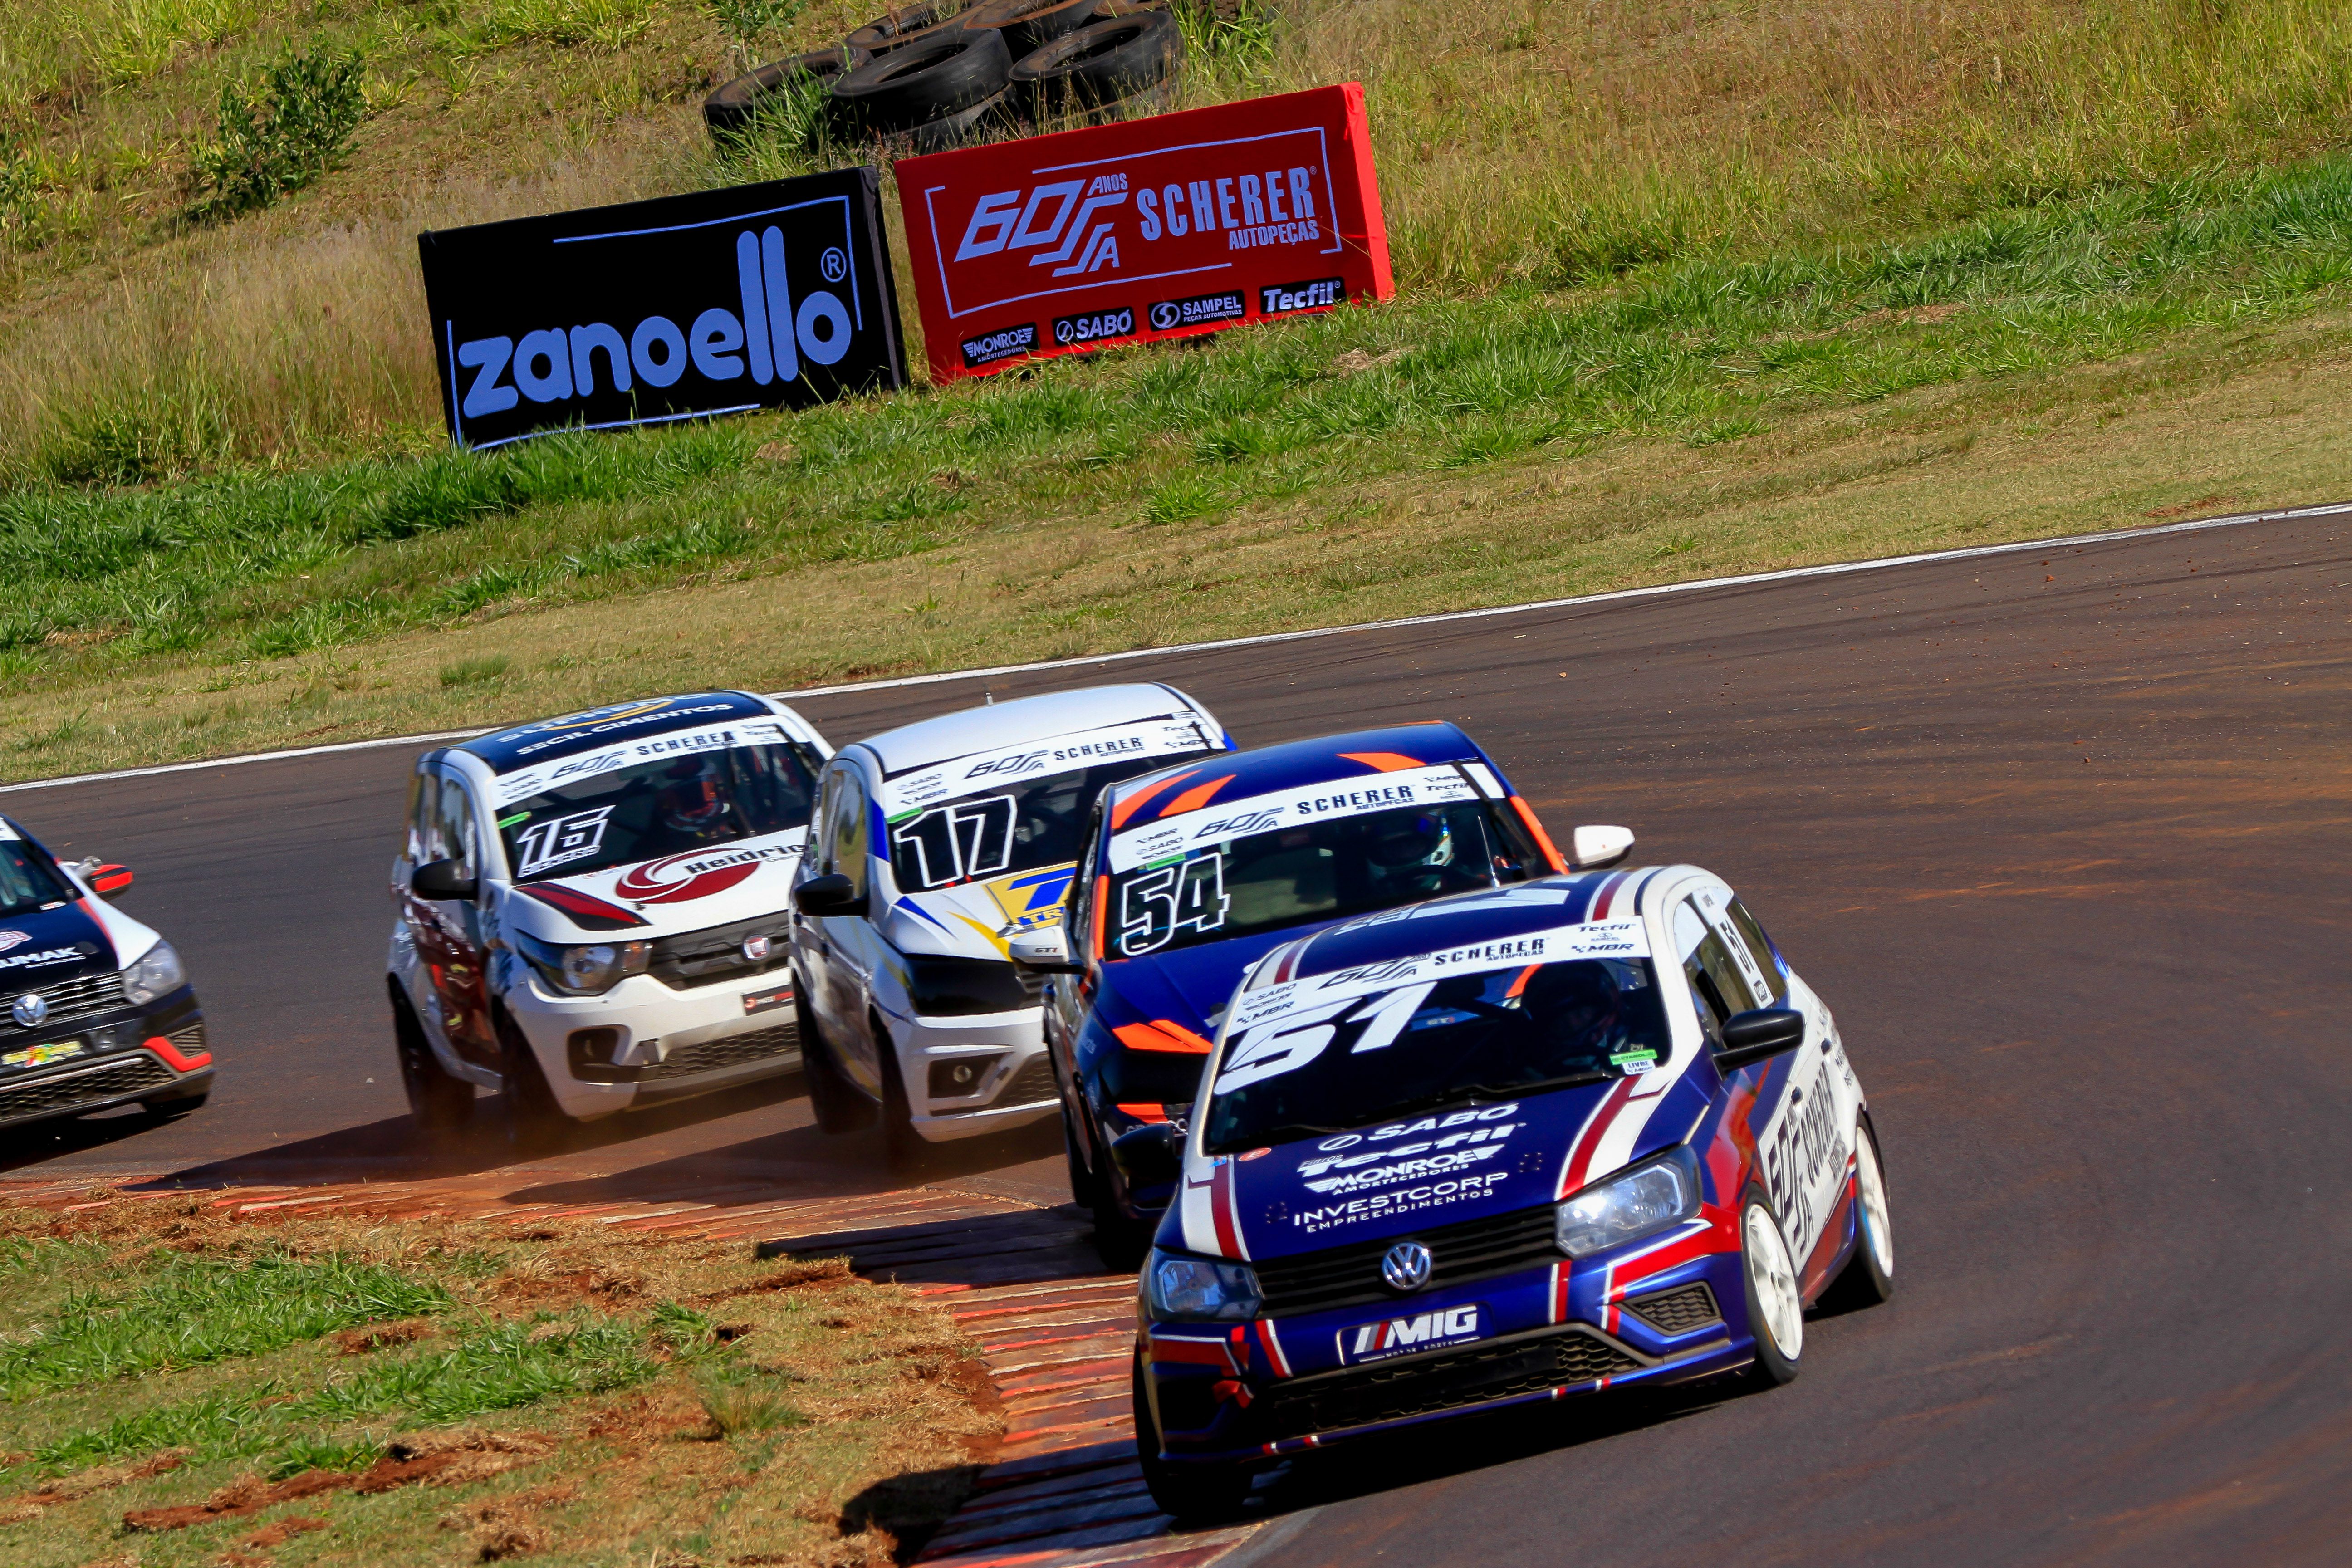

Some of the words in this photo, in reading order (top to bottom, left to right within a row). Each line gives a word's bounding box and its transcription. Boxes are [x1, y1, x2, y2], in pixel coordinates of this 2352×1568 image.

[1087, 172, 1129, 196] ANOS
[1137, 167, 1315, 241] SCHERER
[1229, 219, 1320, 250] AUTOPEÇAS
[1182, 295, 1241, 316] SAMPEL
[1263, 281, 1334, 313] Tecfil
[458, 225, 852, 419] zanoello
[972, 328, 1027, 357] MONROE
[515, 731, 593, 755] SECIL
[590, 704, 734, 733] CIMENTOS
[637, 731, 735, 755] SCHERER
[1053, 736, 1144, 761] SCHERER
[1296, 785, 1415, 815] SCHERER
[893, 794, 1018, 888] 17
[1121, 852, 1231, 956] 54
[1578, 923, 1631, 932] Tecfil
[1434, 938, 1545, 966] SCHERER
[1588, 943, 1635, 952] MBR
[1252, 1000, 1295, 1021] MBR
[1214, 980, 1438, 1095] 51
[1296, 1123, 1517, 1177] Tecfil
[1329, 1149, 1479, 1191] MONROE
[1332, 1163, 1470, 1196] AMORTECEDORES
[1294, 1171, 1509, 1226] INVESTCORP
[1307, 1188, 1494, 1233] EMPREENDIMENTOS
